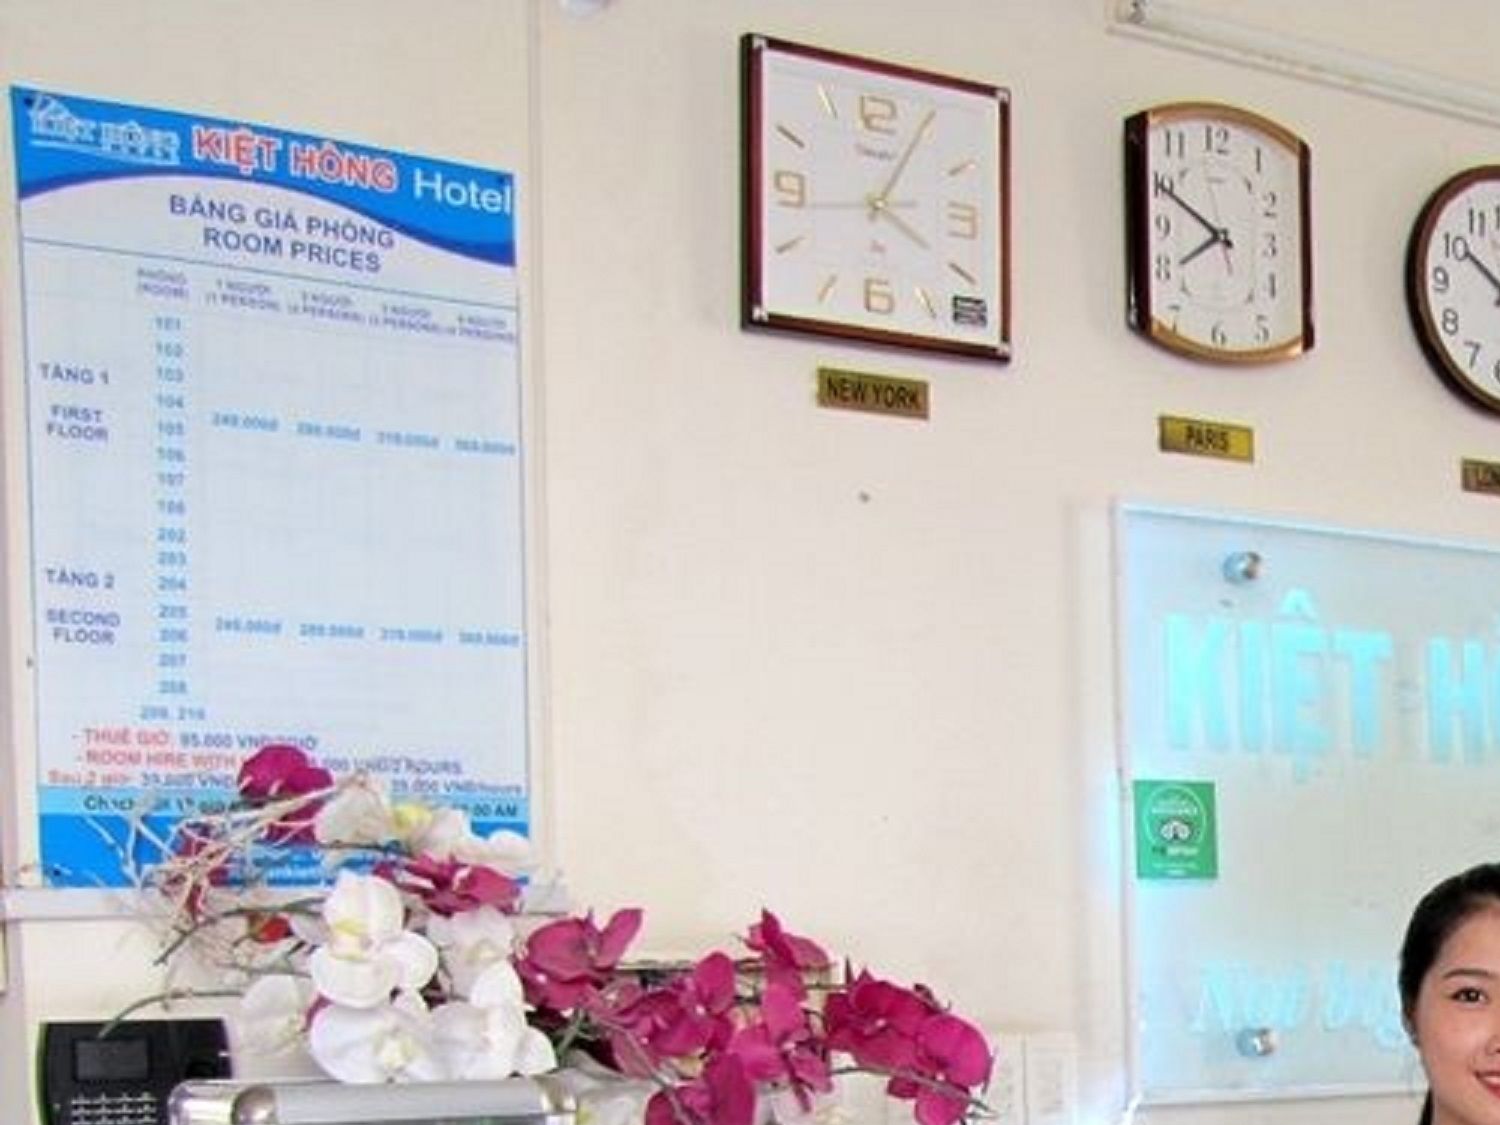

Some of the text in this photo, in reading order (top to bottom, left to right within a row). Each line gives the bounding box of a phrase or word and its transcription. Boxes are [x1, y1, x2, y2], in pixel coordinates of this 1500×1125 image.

[1165, 130, 1185, 158] 11
[1205, 126, 1229, 154] 12
[191, 124, 281, 176] KIỆT
[414, 168, 512, 215] Hotel
[1264, 192, 1277, 217] 2
[1155, 215, 1171, 239] 9
[1468, 208, 1485, 239] 11
[203, 227, 381, 273] ROOM PRICES
[1263, 233, 1277, 257] 3
[1444, 232, 1469, 262] 10
[1155, 254, 1171, 281] 8
[1433, 266, 1449, 293] 9
[1211, 320, 1227, 345] 6
[1254, 314, 1270, 343] 5
[1442, 308, 1459, 335] 8
[1463, 340, 1480, 369] 7
[157, 393, 185, 409] 104
[827, 376, 921, 411] NEW YORK
[52, 404, 104, 424] FIRST
[47, 422, 109, 442] FLOOR
[47, 609, 121, 628] SECOND
[53, 627, 116, 646] FLOOR
[1165, 588, 1393, 784] KIỆT
[86, 750, 141, 766] ROOM
